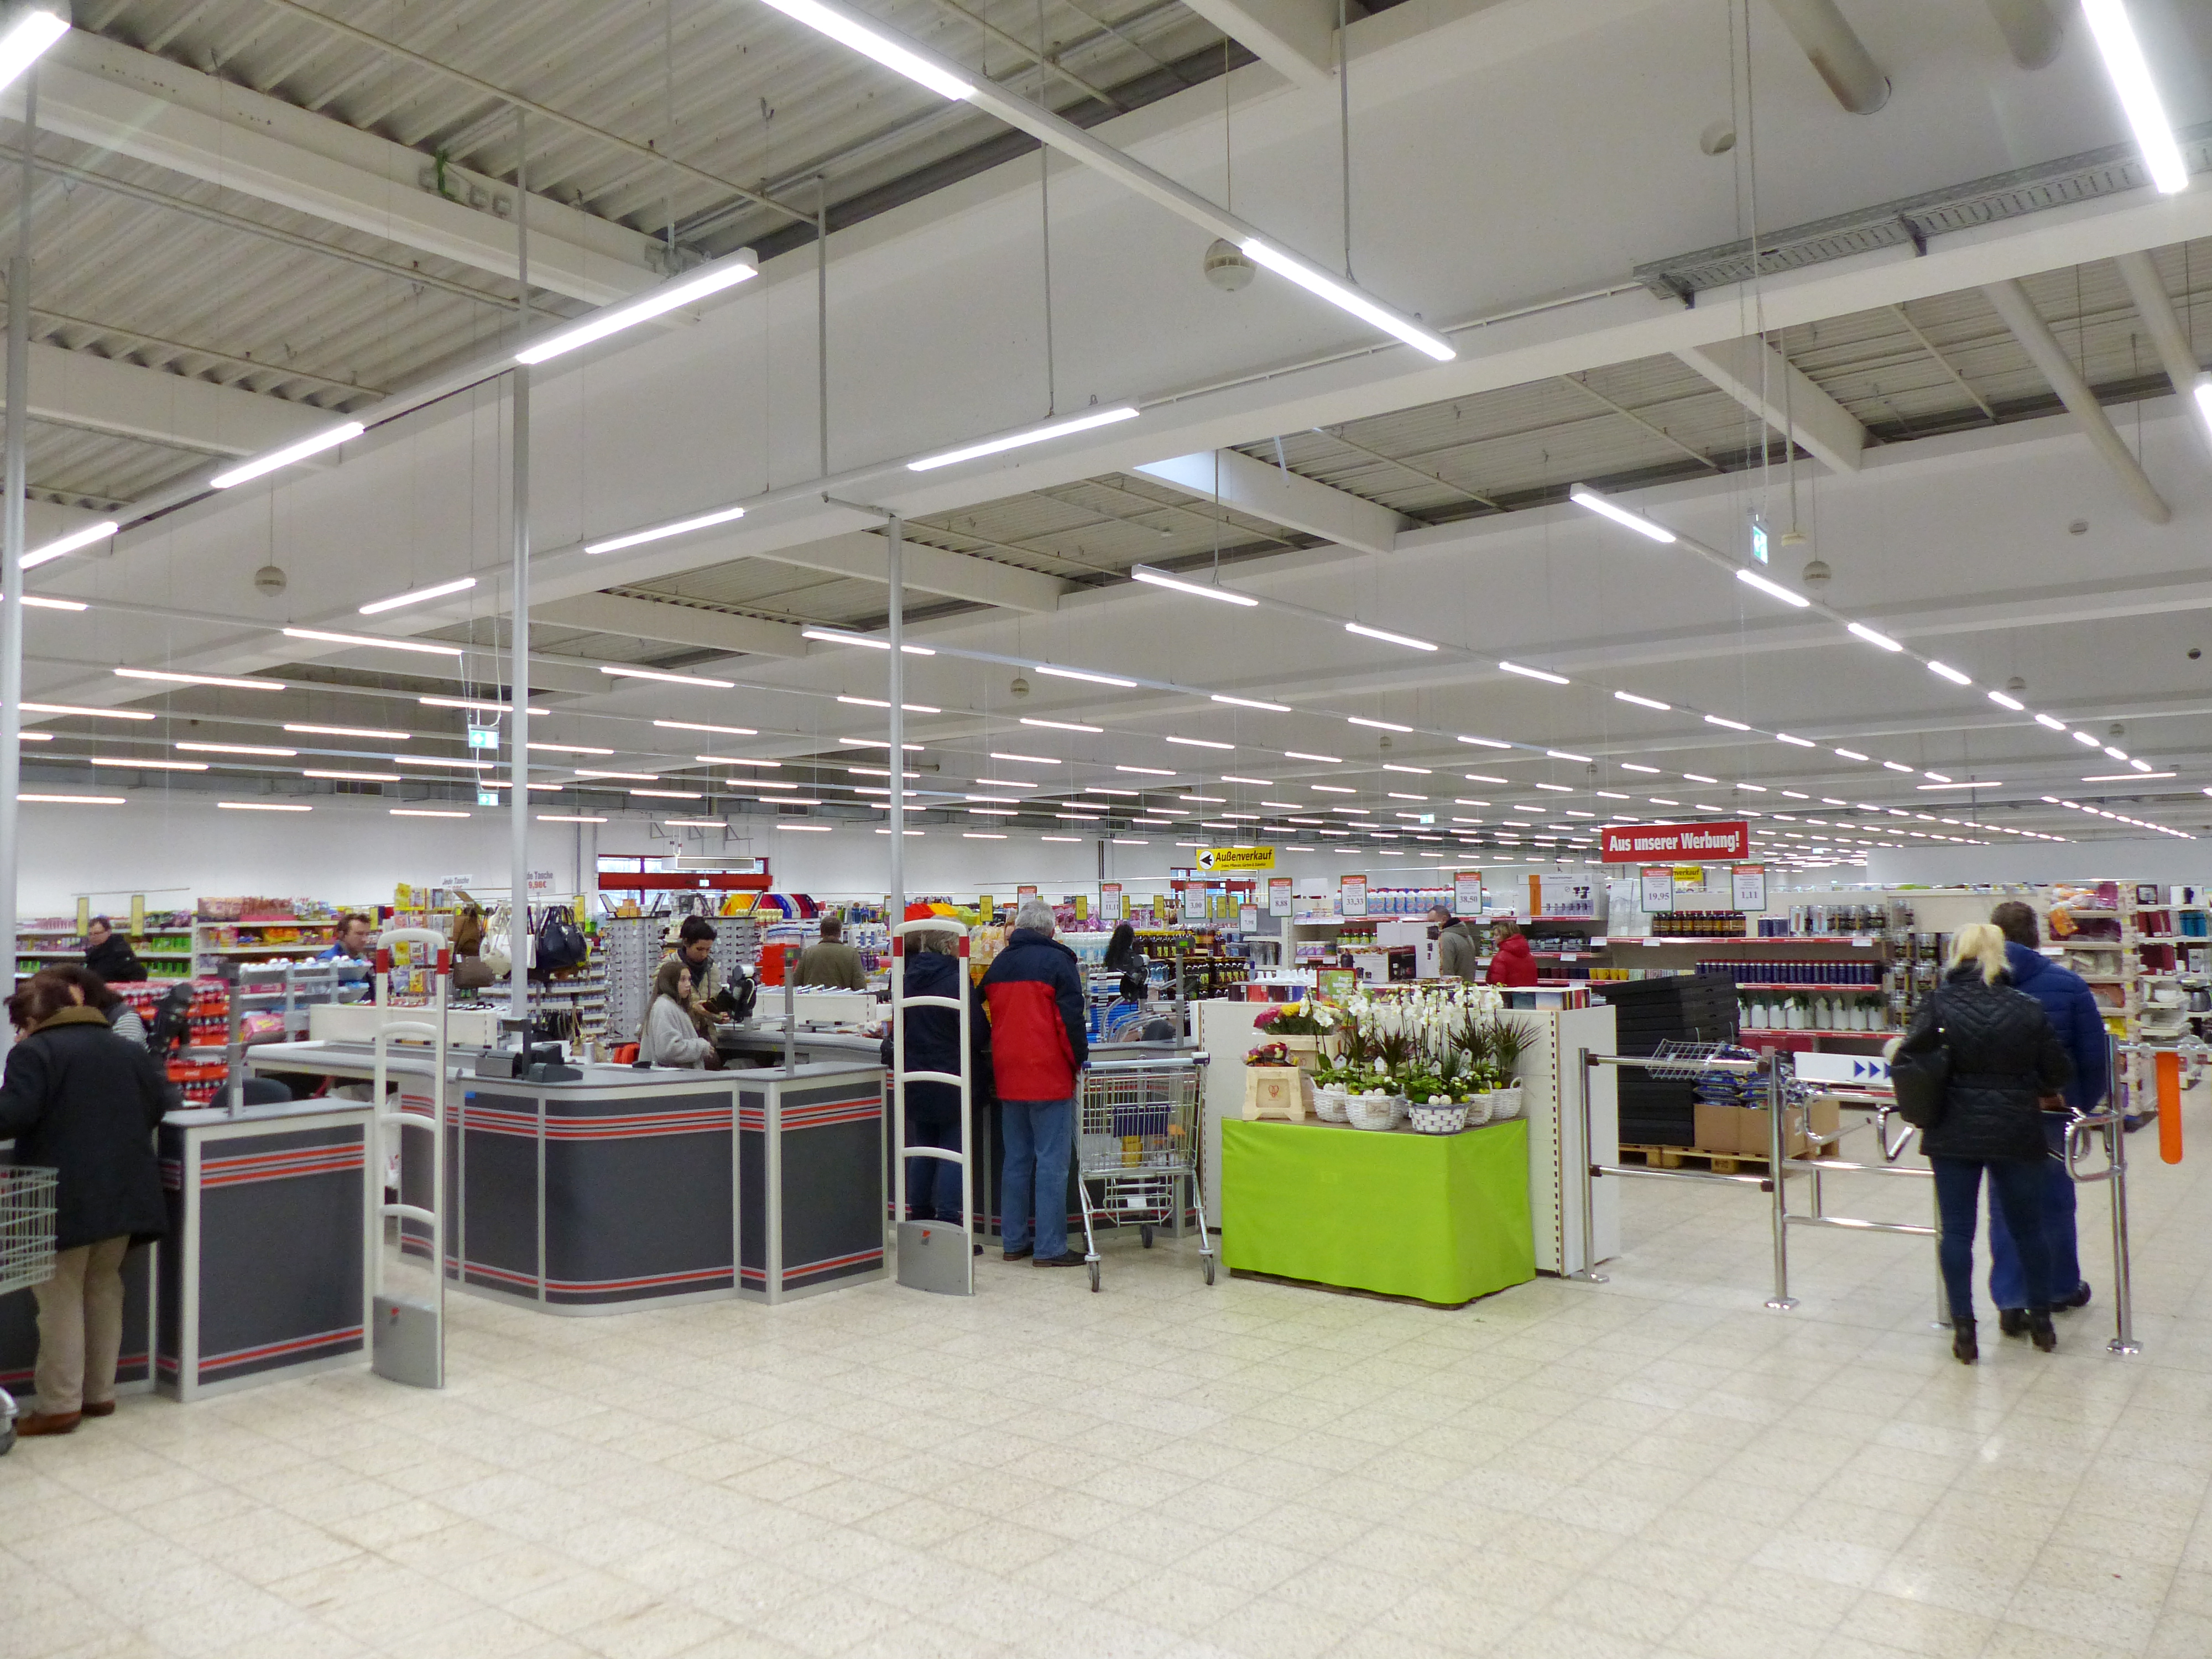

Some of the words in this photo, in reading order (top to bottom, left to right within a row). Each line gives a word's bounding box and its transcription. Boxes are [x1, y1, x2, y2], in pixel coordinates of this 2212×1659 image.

[1609, 836, 1631, 852] Aus
[1634, 837, 1678, 851] unserer
[1681, 831, 1740, 852] Werbung!
[1215, 849, 1272, 862] Außenverkauf
[534, 870, 553, 880] Tasche
[1346, 898, 1364, 906] 33,33
[1648, 893, 1670, 901] 19,95
